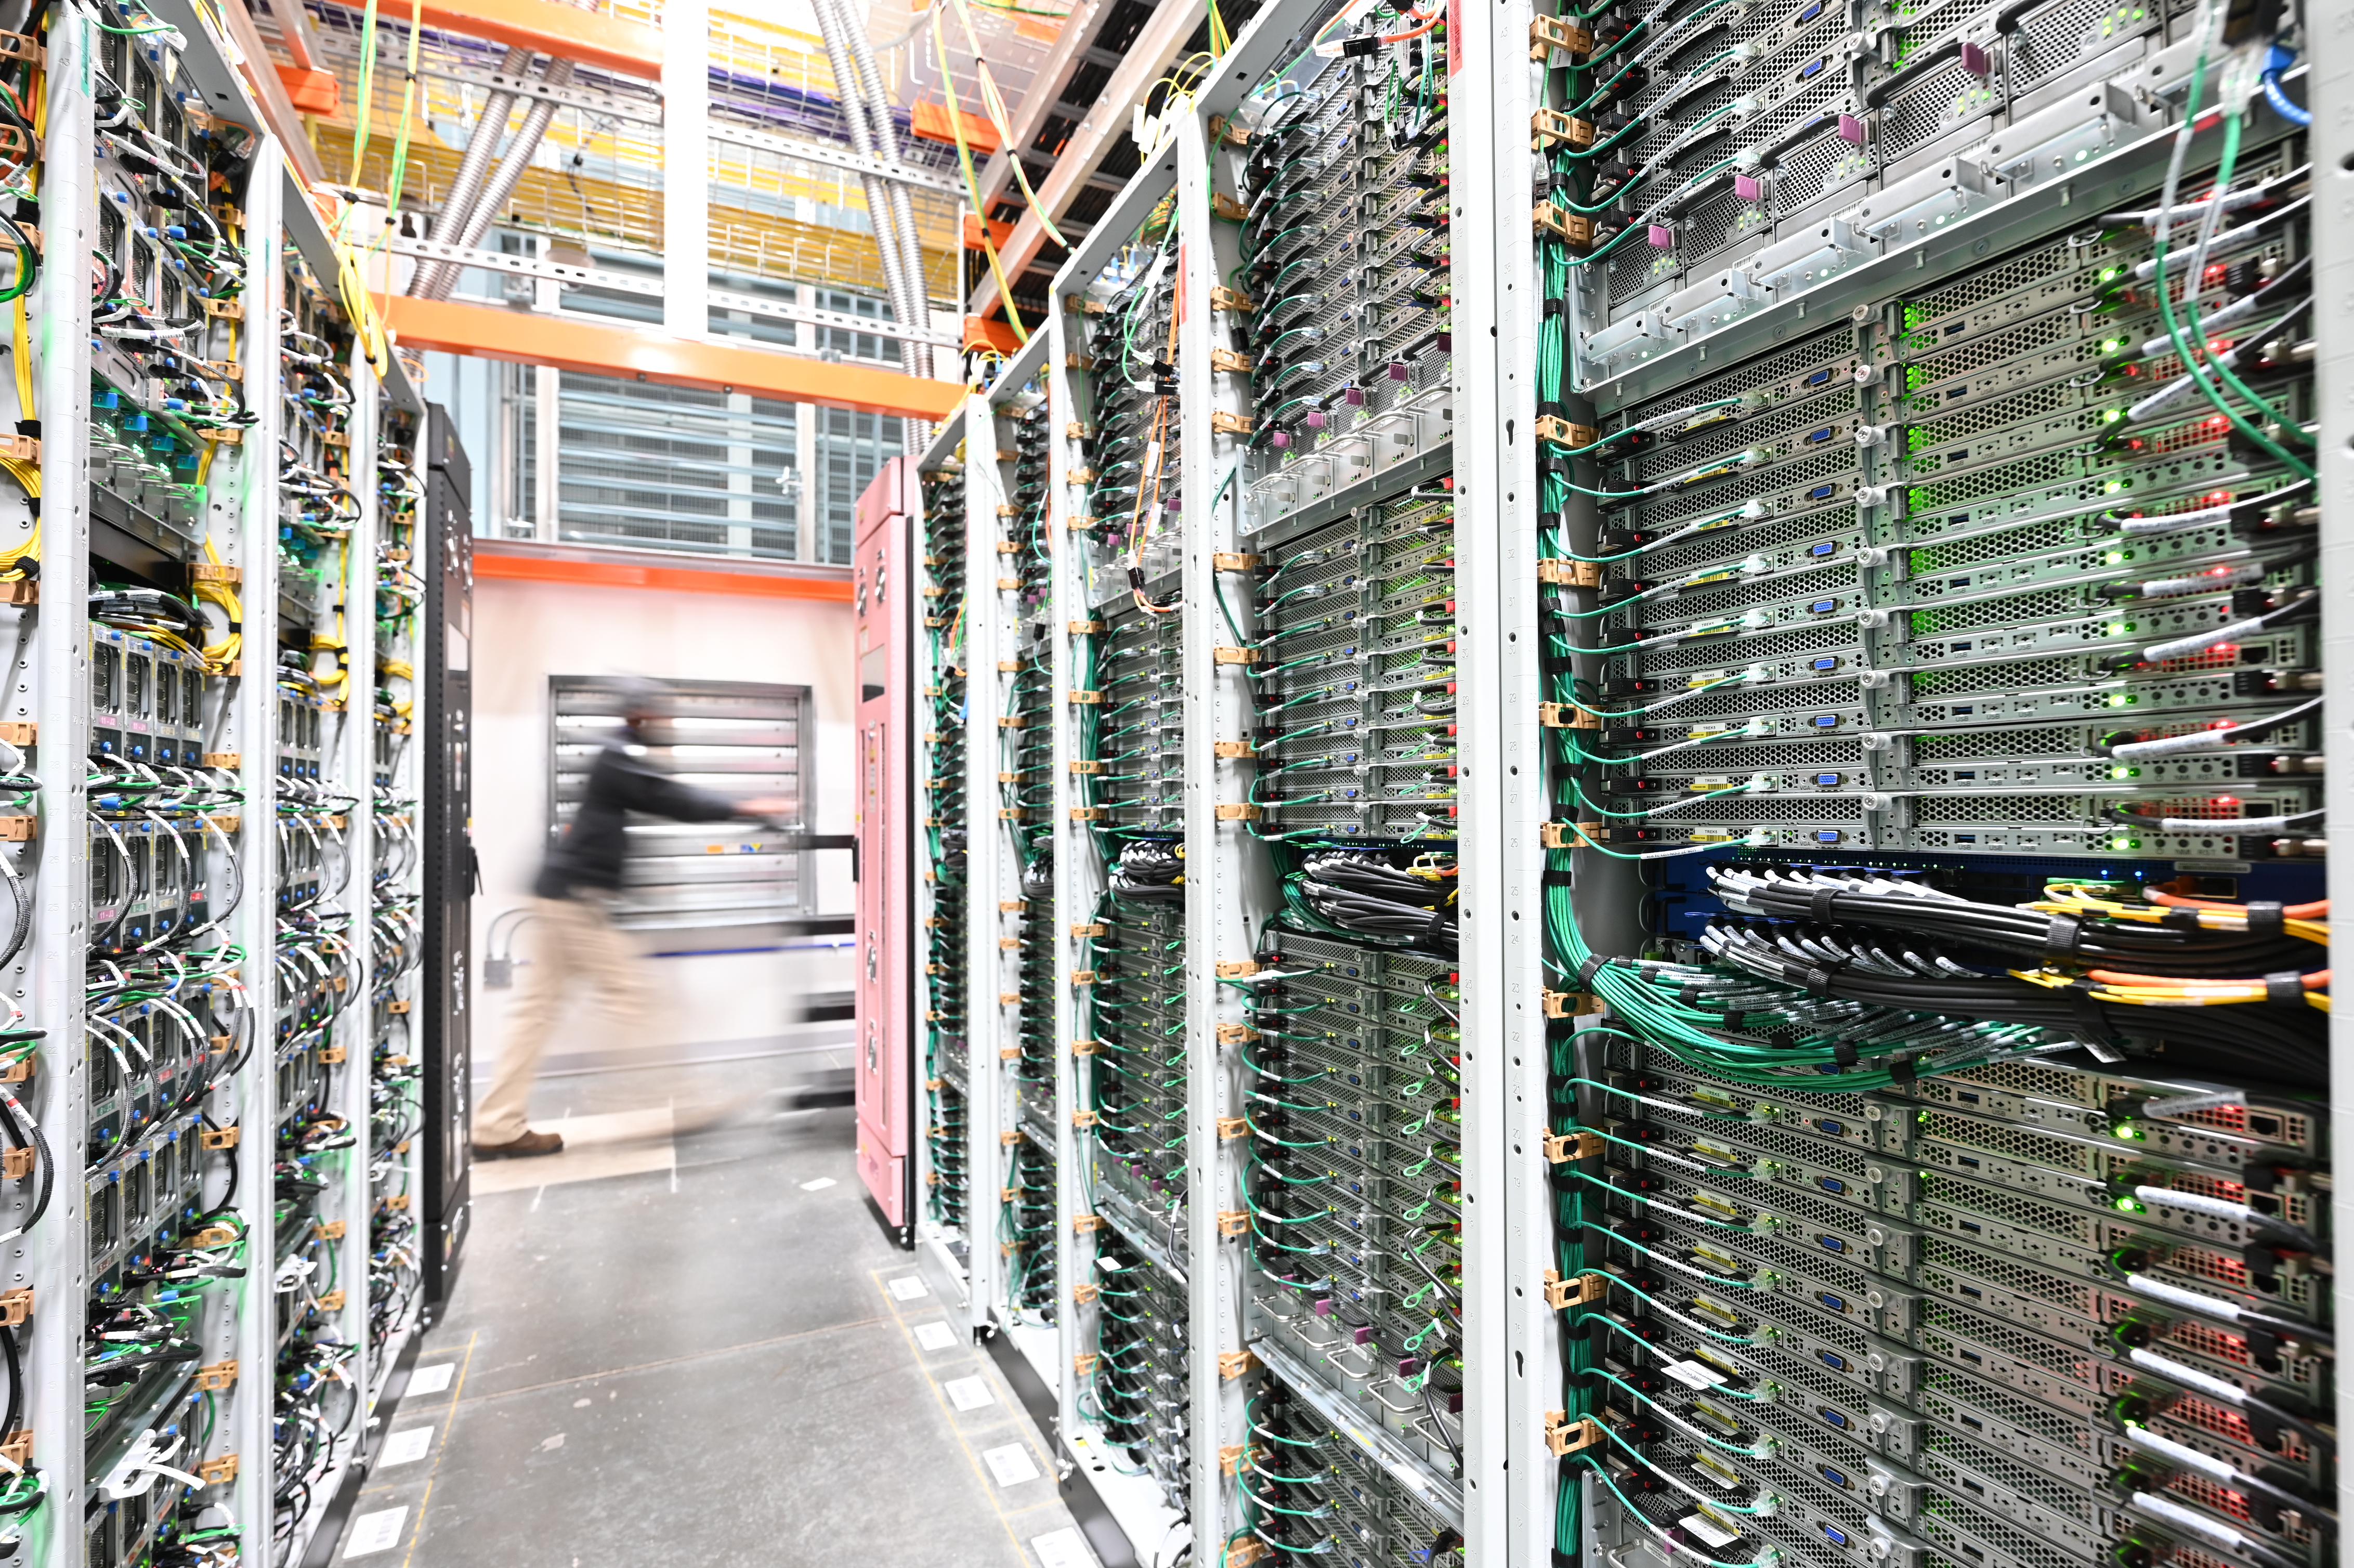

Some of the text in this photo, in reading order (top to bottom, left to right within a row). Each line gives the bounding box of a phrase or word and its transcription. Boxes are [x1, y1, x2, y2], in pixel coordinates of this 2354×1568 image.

[1502, 168, 1510, 180] 40
[56, 196, 68, 206] 40
[1503, 216, 1511, 227] 39
[55, 243, 67, 252] 39
[1504, 264, 1511, 274] 38
[1457, 275, 1463, 286] 38
[54, 290, 66, 299] 38
[1505, 311, 1512, 321] 37
[1457, 321, 1463, 332] 37
[1506, 358, 1512, 369] 36
[1458, 368, 1465, 380] 36
[1506, 405, 1513, 415] 35
[1459, 414, 1466, 425] 35
[1506, 453, 1513, 463] 34
[1459, 461, 1466, 472] 34
[52, 477, 64, 486] 34
[1460, 507, 1467, 518] 33
[1507, 505, 1514, 515] 33
[52, 524, 63, 533] 33
[1507, 548, 1515, 558] 32
[1460, 554, 1467, 564] 32
[51, 571, 62, 580] 32
[1461, 601, 1468, 611] 31
[1508, 597, 1515, 606] 31
[51, 619, 62, 628] 31
[1461, 648, 1468, 658] 30
[1508, 645, 1516, 654] 30
[50, 665, 61, 674] 30
[1462, 696, 1469, 705] 29
[1509, 694, 1516, 703] 29
[50, 713, 61, 723] 29
[1463, 743, 1470, 753] 28
[1510, 741, 1517, 751] 28
[49, 761, 61, 769] 28
[1463, 795, 1470, 804] 27
[1510, 794, 1517, 804] 27
[48, 808, 60, 817] 27
[1464, 838, 1471, 847] 26
[1511, 838, 1518, 847] 26
[48, 855, 59, 865] 26
[1464, 885, 1471, 894] 25
[1511, 887, 1518, 896] 25
[47, 903, 59, 912] 25
[1464, 932, 1471, 942] 24
[1511, 935, 1519, 945] 24
[47, 951, 59, 960] 24
[1465, 979, 1472, 989] 23
[1512, 984, 1519, 992] 23
[47, 999, 58, 1008] 23
[1466, 1027, 1472, 1038] 22
[1512, 1032, 1520, 1042] 22
[46, 1047, 58, 1055] 22
[1967, 1492, 1980, 1500] USB
